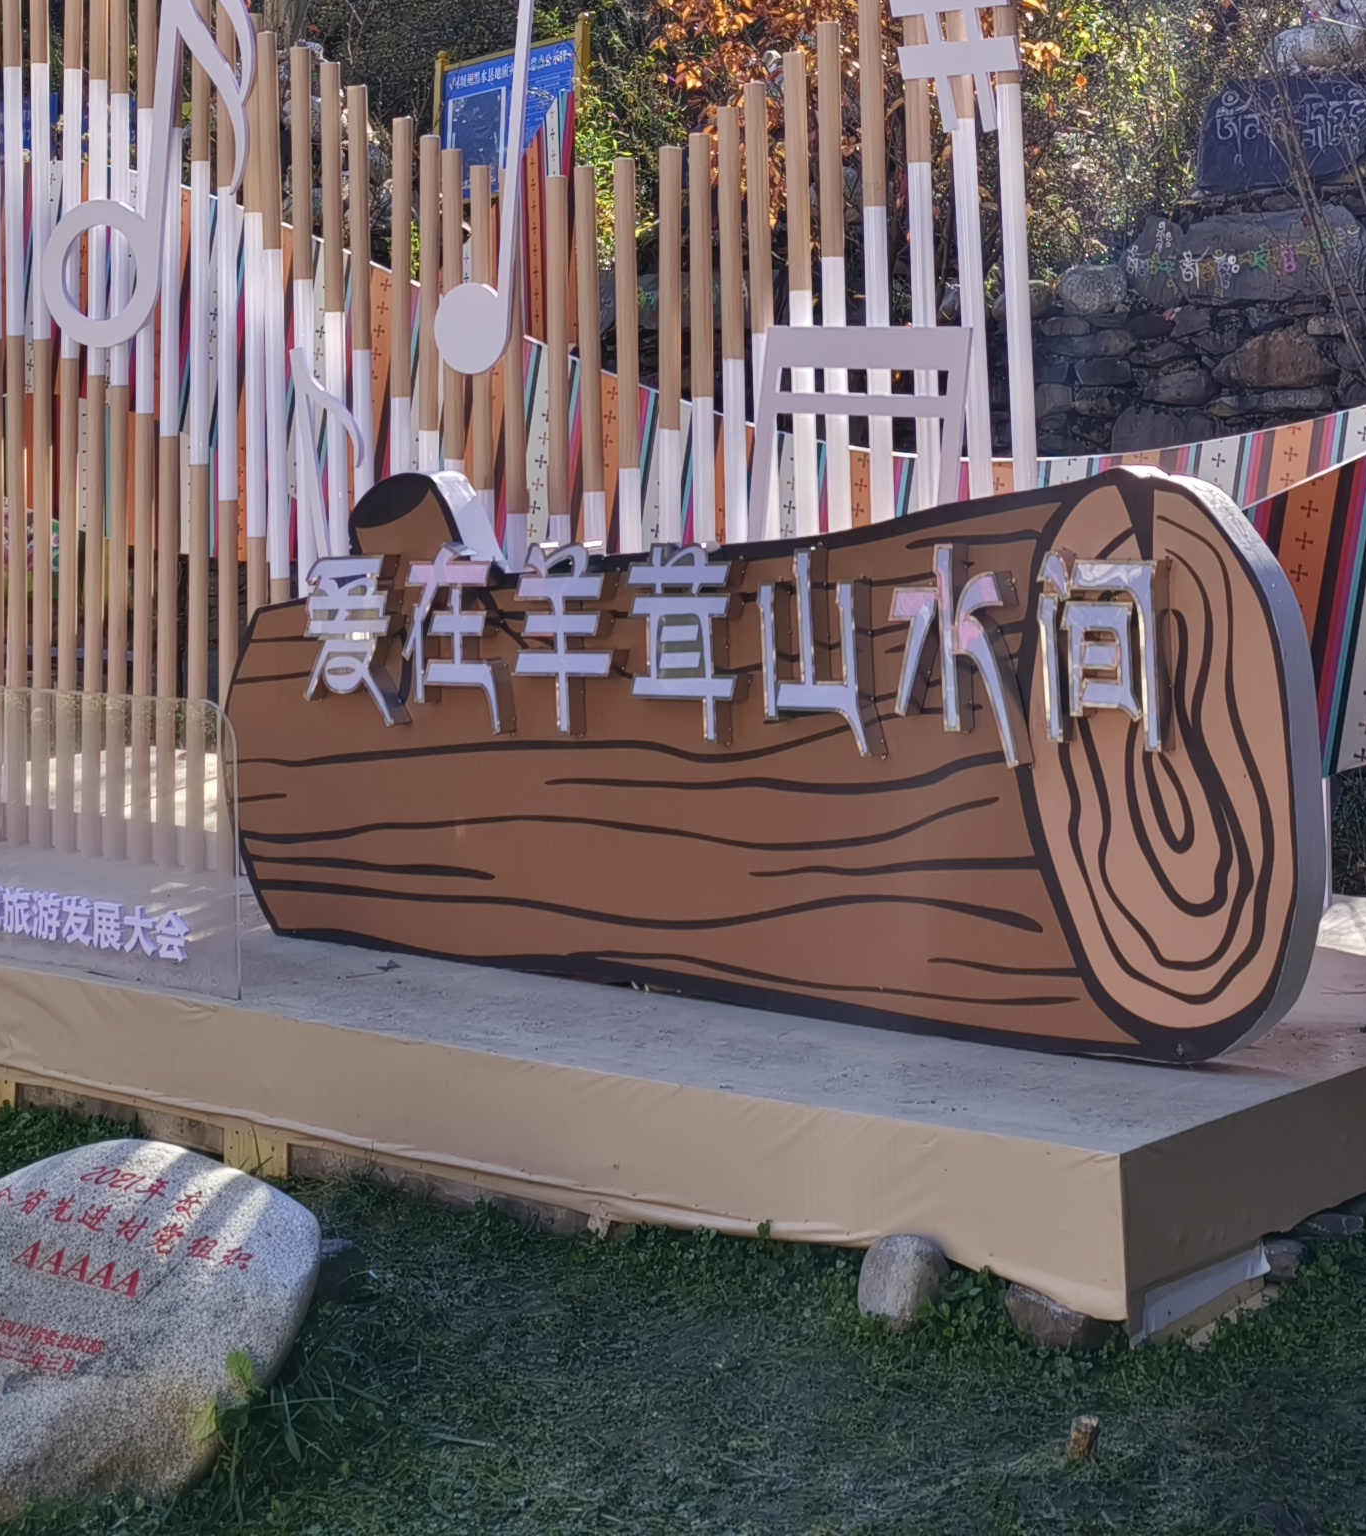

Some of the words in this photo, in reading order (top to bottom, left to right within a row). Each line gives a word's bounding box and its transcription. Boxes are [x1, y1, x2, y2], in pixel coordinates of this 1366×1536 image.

[304, 542, 1172, 769] 爱在羊茸山水间
[79, 1165, 204, 1219] 2021年度
[11, 1238, 141, 1298] AAAAA
